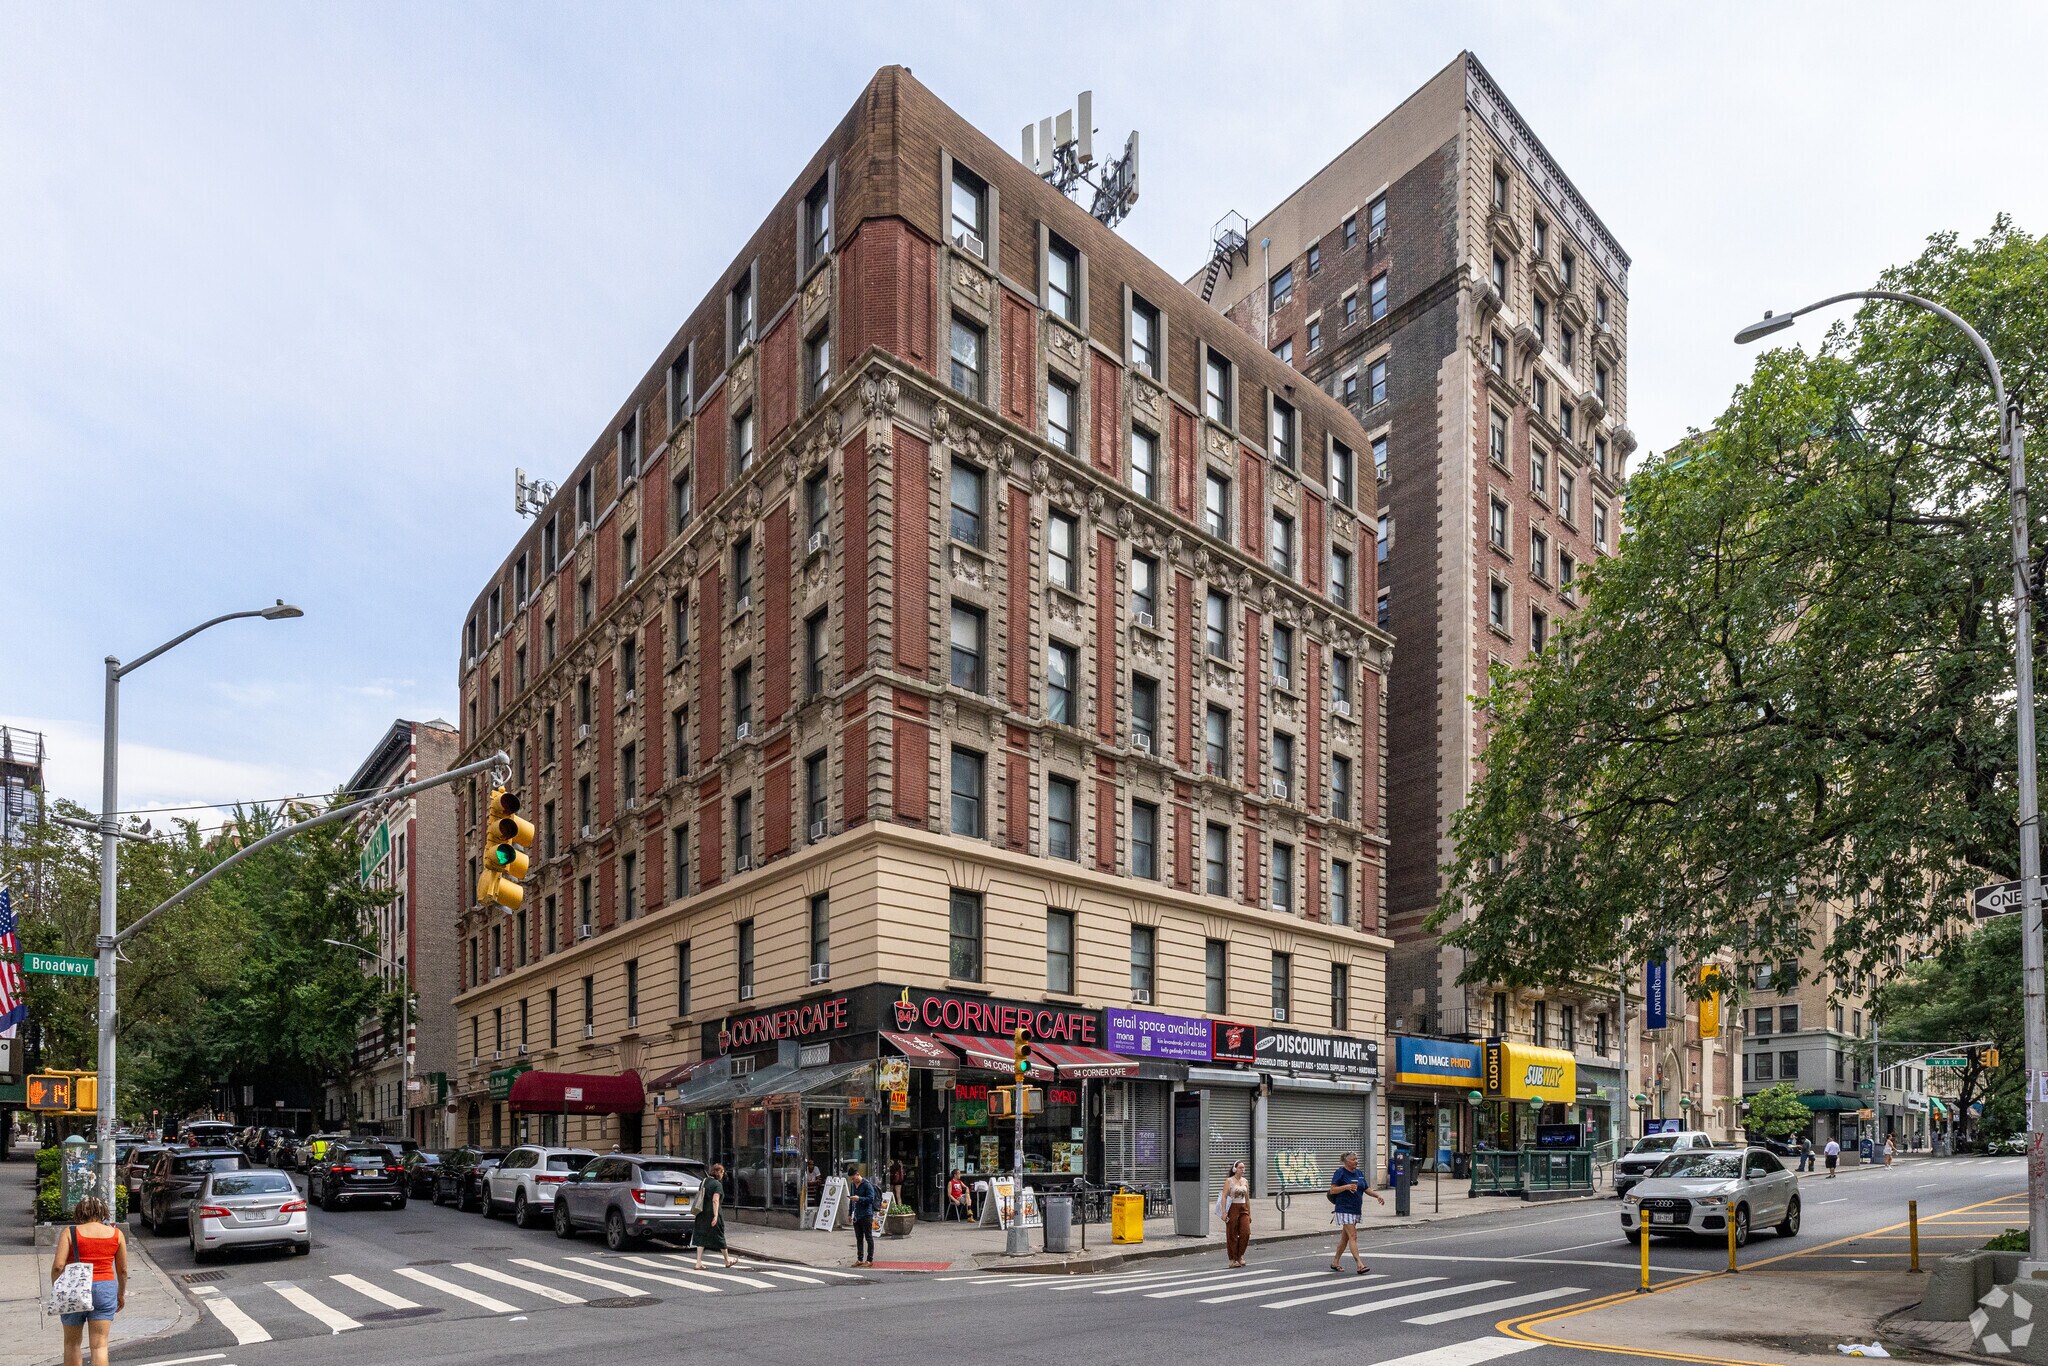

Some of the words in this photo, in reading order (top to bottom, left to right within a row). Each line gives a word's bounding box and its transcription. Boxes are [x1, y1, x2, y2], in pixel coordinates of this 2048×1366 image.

[1990, 890, 2021, 907] ONE
[33, 957, 88, 976] Broadway
[898, 1009, 911, 1023] 94
[1114, 1014, 1136, 1028] retail
[1139, 1020, 1165, 1034] space
[1168, 1021, 1206, 1036] available
[1276, 1034, 1330, 1057] DISCOUNT
[1334, 1041, 1362, 1060] MART
[983, 1060, 991, 1068] 94
[993, 1061, 1015, 1073] CORNE
[1024, 1069, 1039, 1078] AFE
[1254, 1057, 1276, 1066] OUSEHOLD
[1277, 1059, 1288, 1067] ITEMS
[1414, 1054, 1428, 1065] PRO
[1429, 1055, 1449, 1067] IMAGE
[1450, 1058, 1471, 1069] PHOTO
[1490, 1049, 1498, 1089] PHOTO
[1082, 1068, 1109, 1077] CORNER
[1110, 1068, 1126, 1076] CAFE
[1525, 1065, 1564, 1088] SUBWAY
[892, 1092, 906, 1102] ATM
[956, 1084, 987, 1100] FALAFEL
[1050, 1090, 1076, 1104] GYRO
